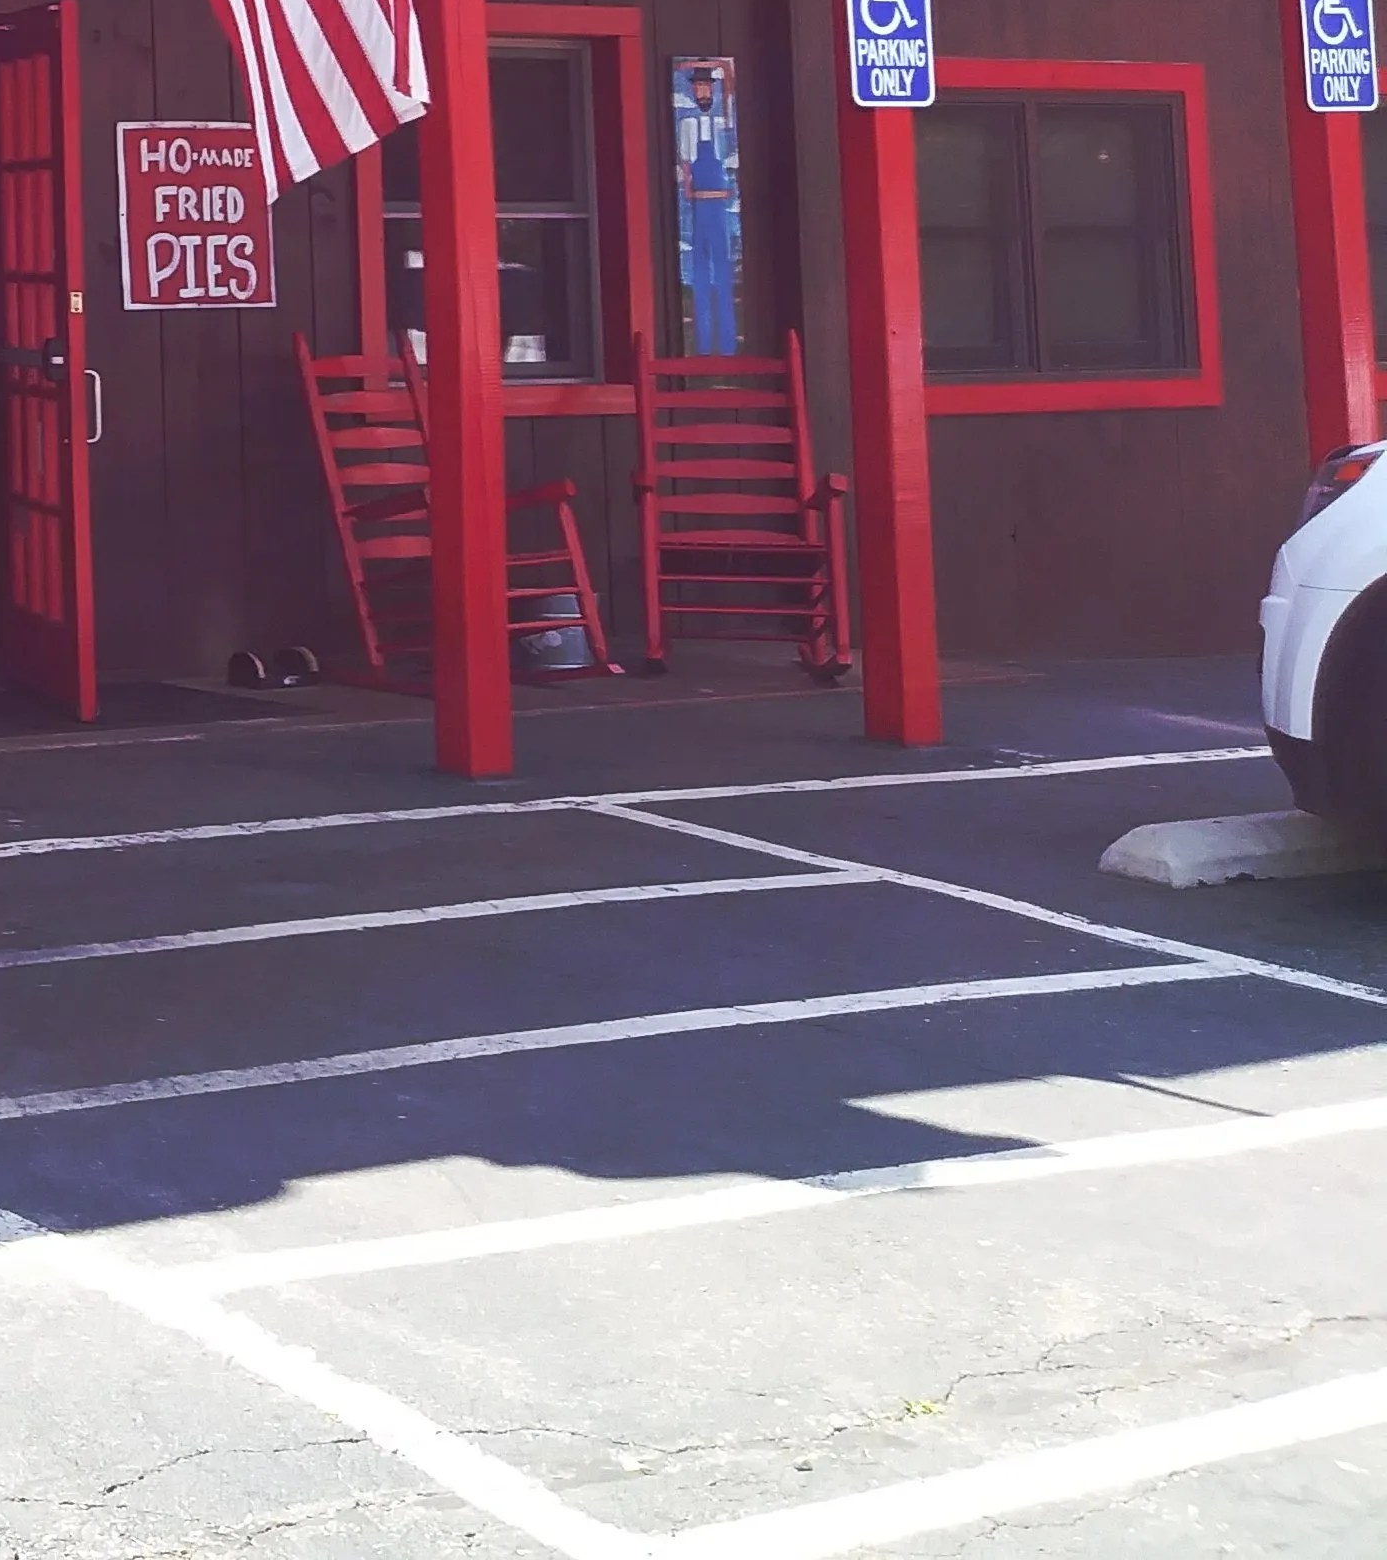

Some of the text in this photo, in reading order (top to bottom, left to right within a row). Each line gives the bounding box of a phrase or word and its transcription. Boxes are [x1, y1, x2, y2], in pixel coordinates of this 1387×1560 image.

[857, 38, 926, 68] PARKING
[1310, 47, 1370, 75] PARKING
[870, 68, 915, 97] ONLY
[1323, 75, 1361, 103] ONLY
[154, 185, 245, 224] FRIED
[146, 232, 257, 300] PIES
